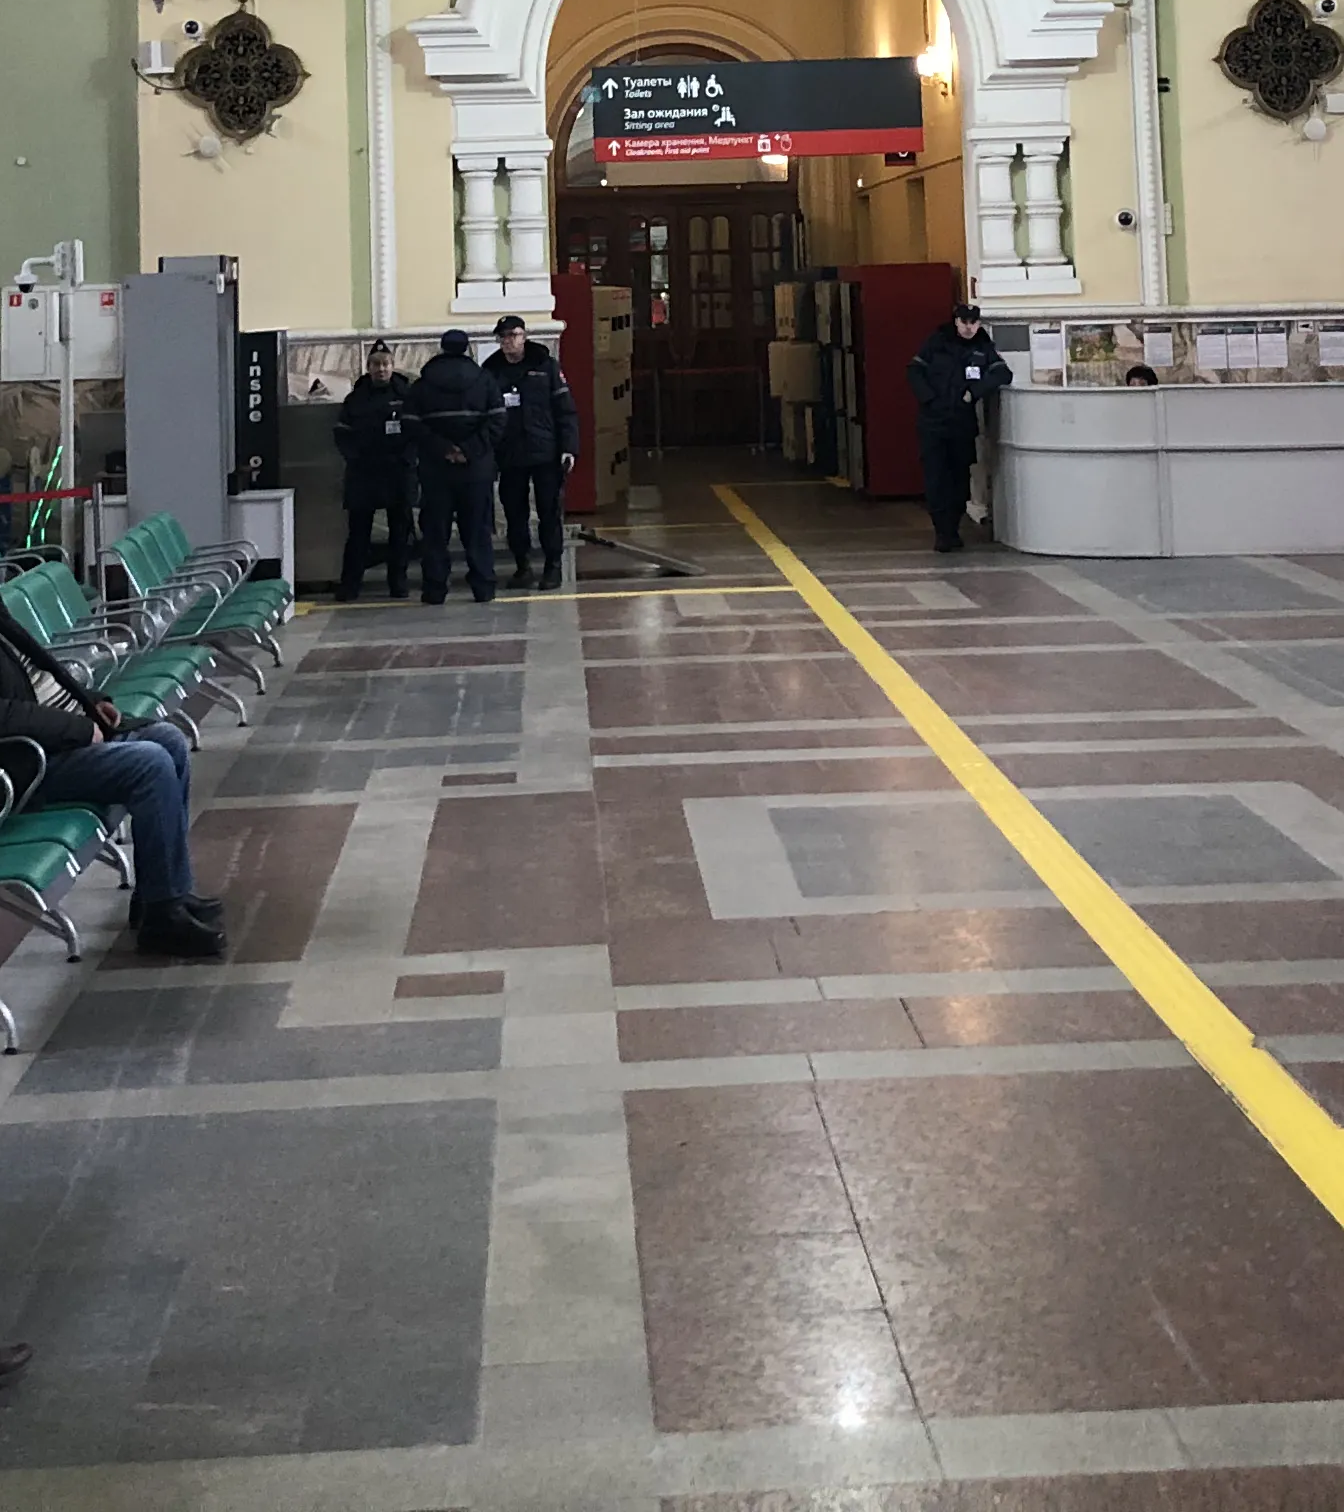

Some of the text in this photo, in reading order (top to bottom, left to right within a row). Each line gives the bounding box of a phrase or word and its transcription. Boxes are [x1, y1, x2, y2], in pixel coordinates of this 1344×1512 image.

[623, 76, 672, 90] Туалеты
[624, 89, 653, 99] Toilets
[623, 108, 708, 120] Зал ожидания
[624, 121, 675, 132] Sitting area
[625, 139, 660, 149] Камера
[709, 136, 754, 146] Медпункт
